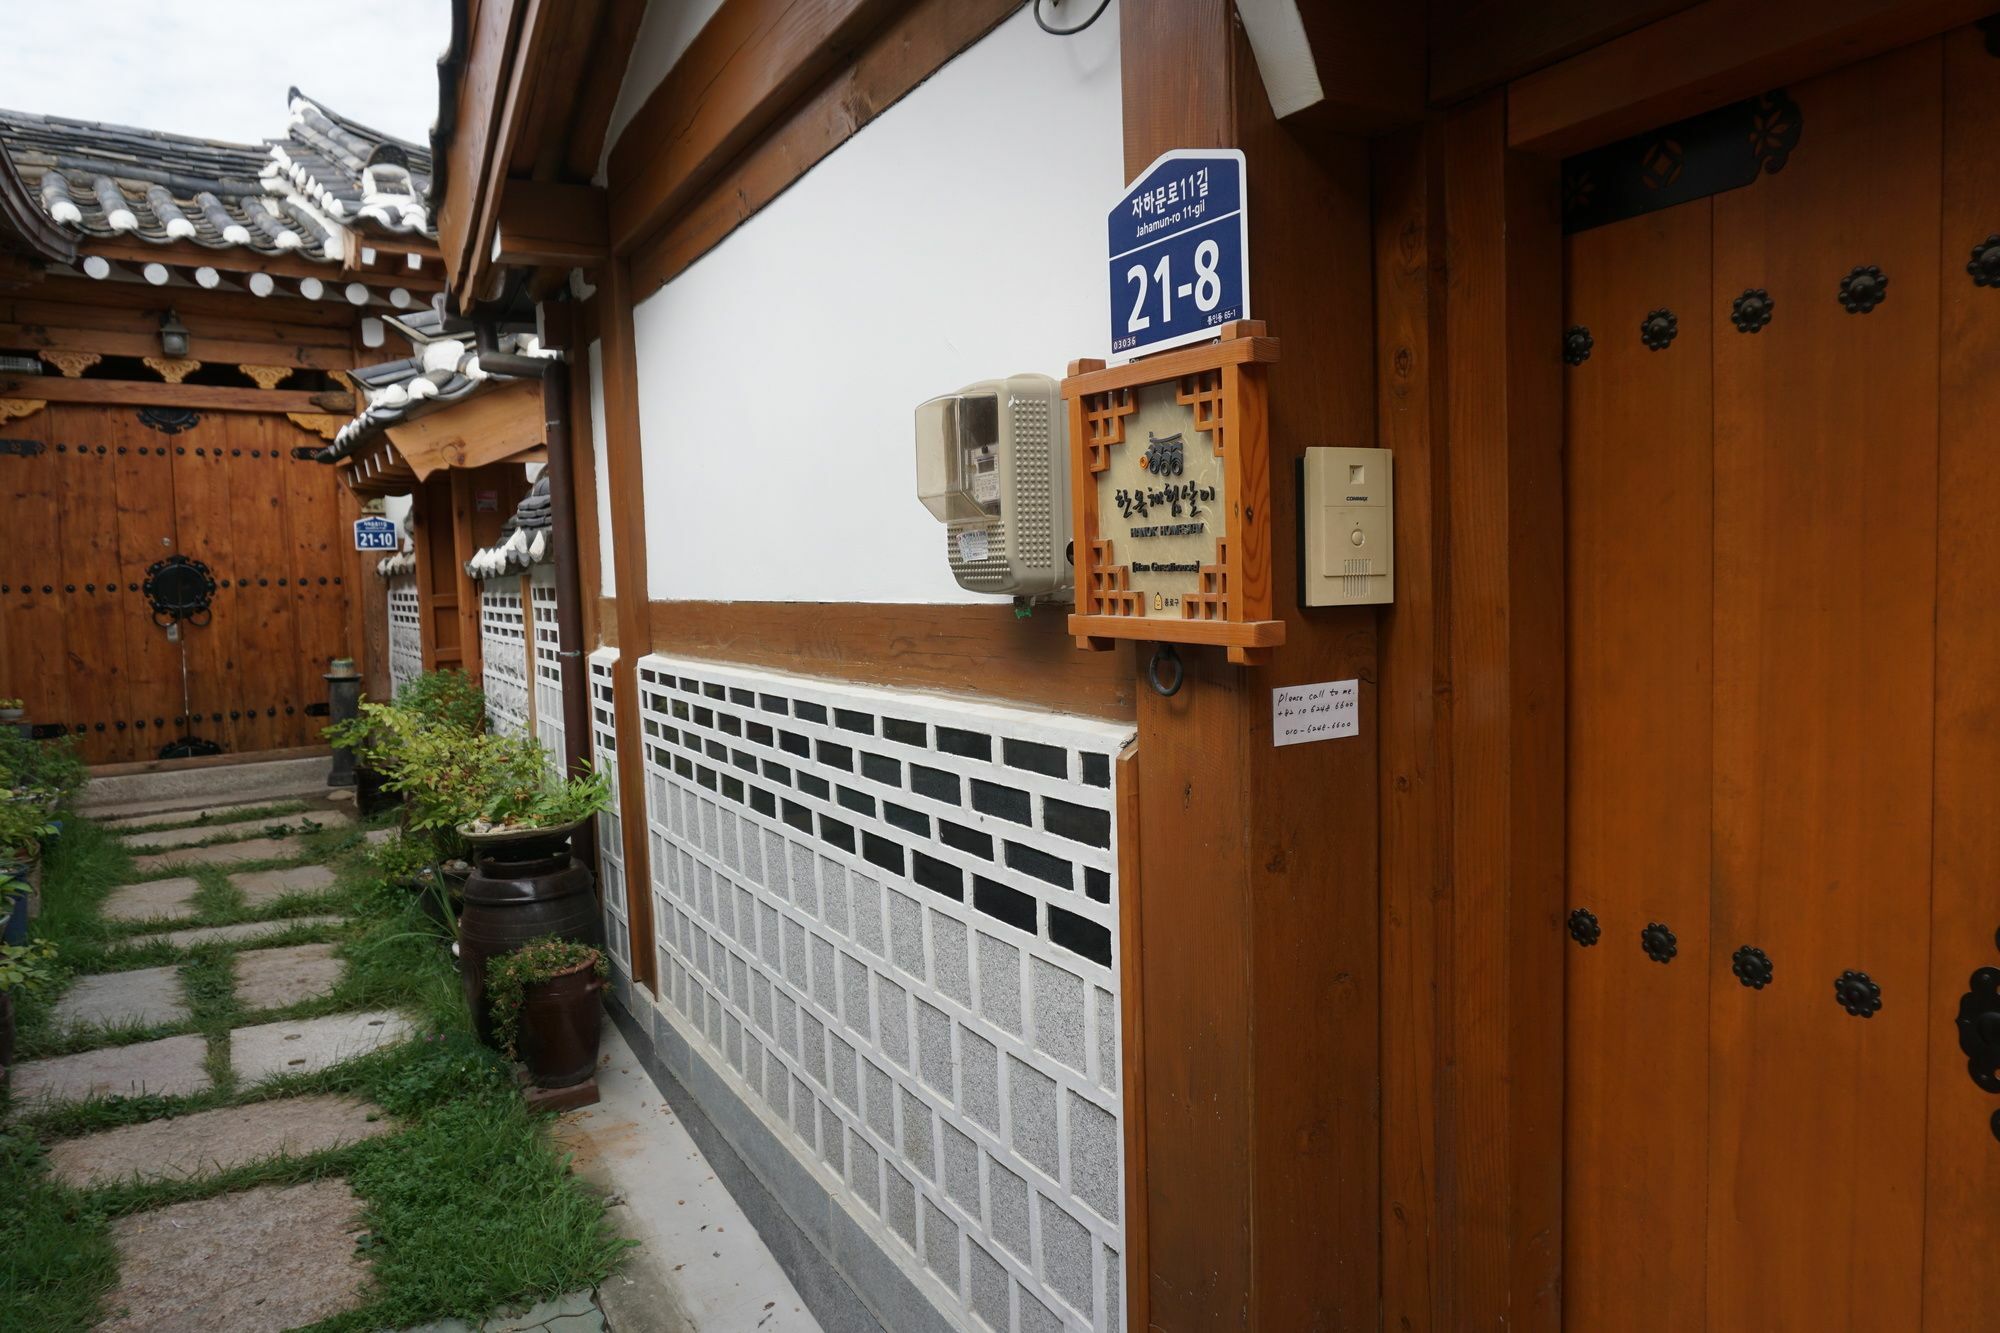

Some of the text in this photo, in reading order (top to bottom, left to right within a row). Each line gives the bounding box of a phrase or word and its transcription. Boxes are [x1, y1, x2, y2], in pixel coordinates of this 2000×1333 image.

[1132, 167, 1209, 218] 자하문로11길
[1136, 199, 1205, 238] Jahamun-ro 11-gil
[1127, 239, 1221, 333] 21-8
[1113, 336, 1136, 350] 03036
[360, 533, 392, 546] 21-10
[1309, 690, 1325, 700] call
